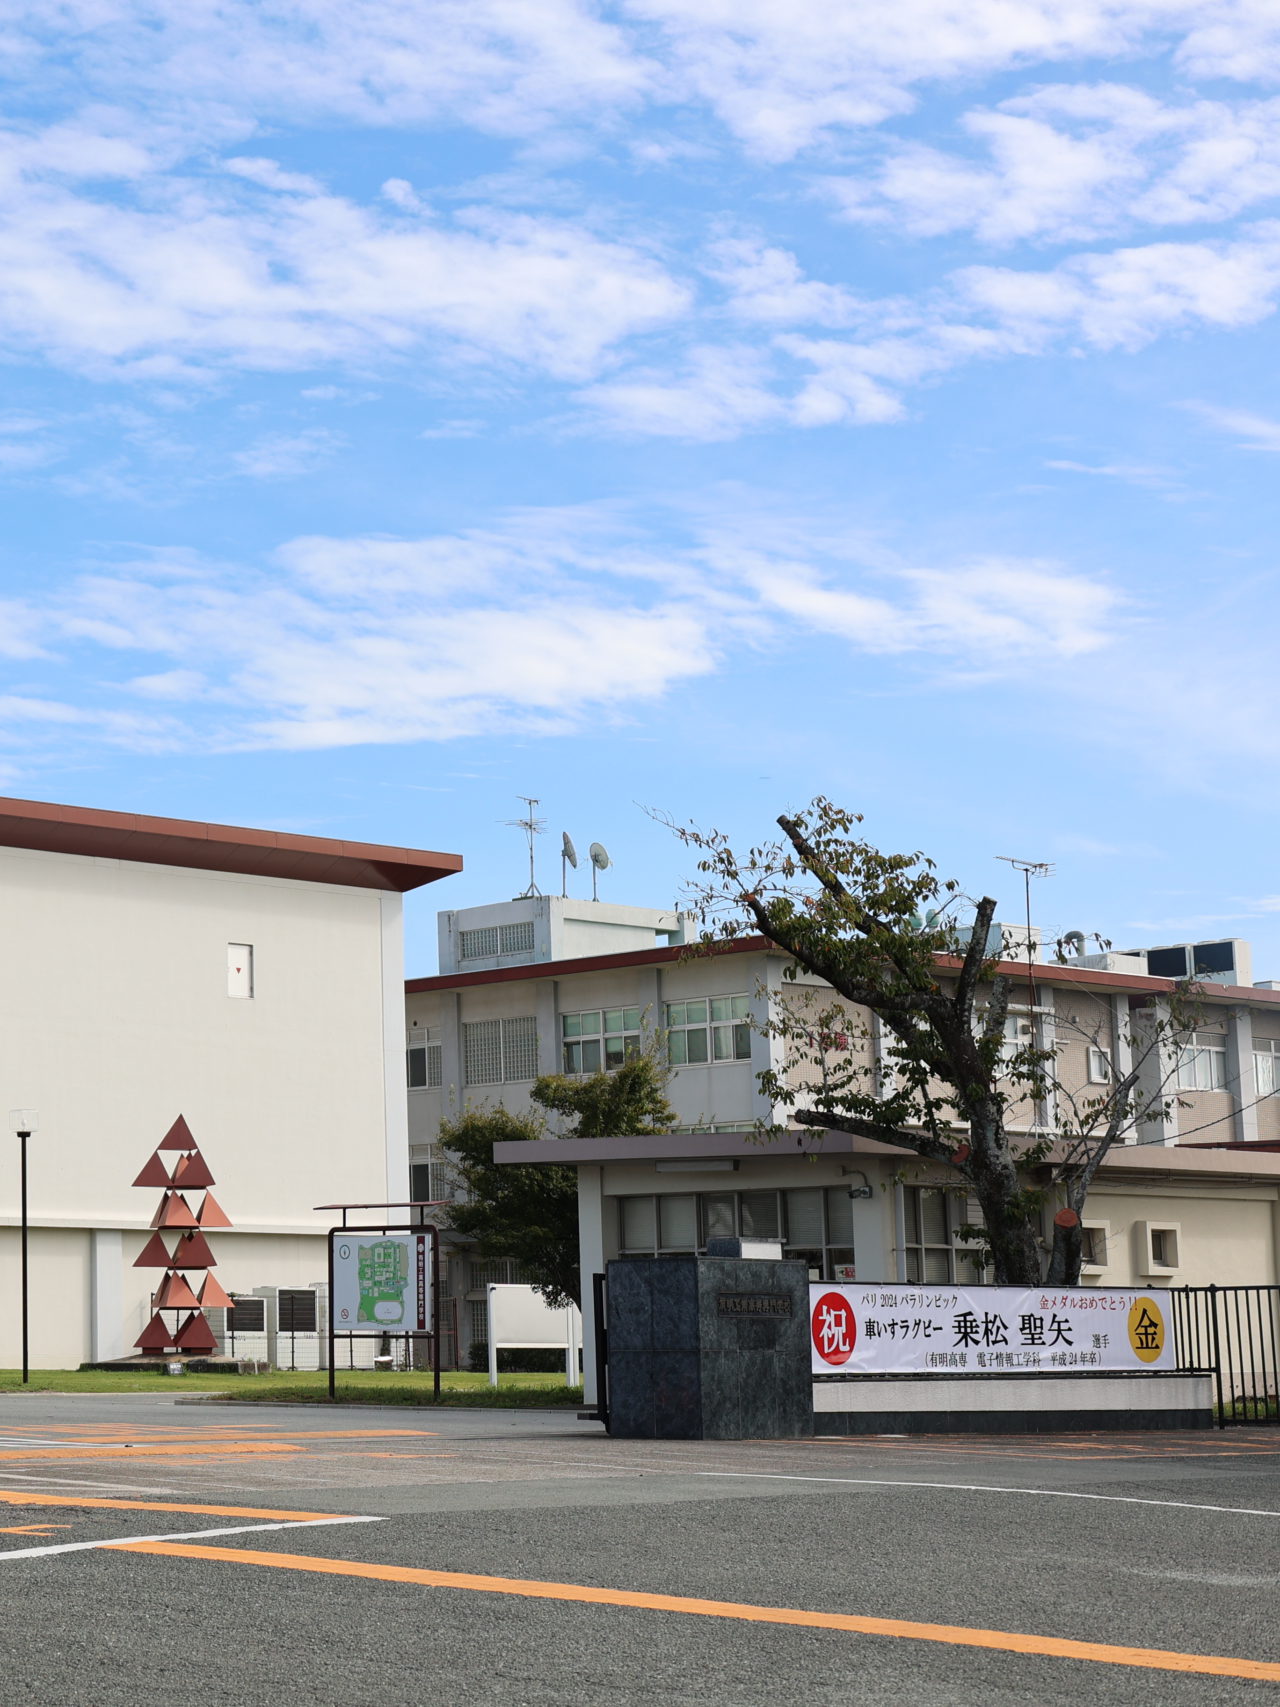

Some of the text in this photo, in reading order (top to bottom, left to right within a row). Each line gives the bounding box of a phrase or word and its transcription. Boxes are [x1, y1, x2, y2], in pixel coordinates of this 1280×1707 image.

[861, 1293, 958, 1309] パリ 2024 パラリンピック
[818, 1305, 850, 1354] 祝
[864, 1311, 1110, 1349] 車いすラグビー 乗松 聖矢 選手
[1134, 1308, 1160, 1350] 金
[976, 1352, 1041, 1368] 電子情報工学科
